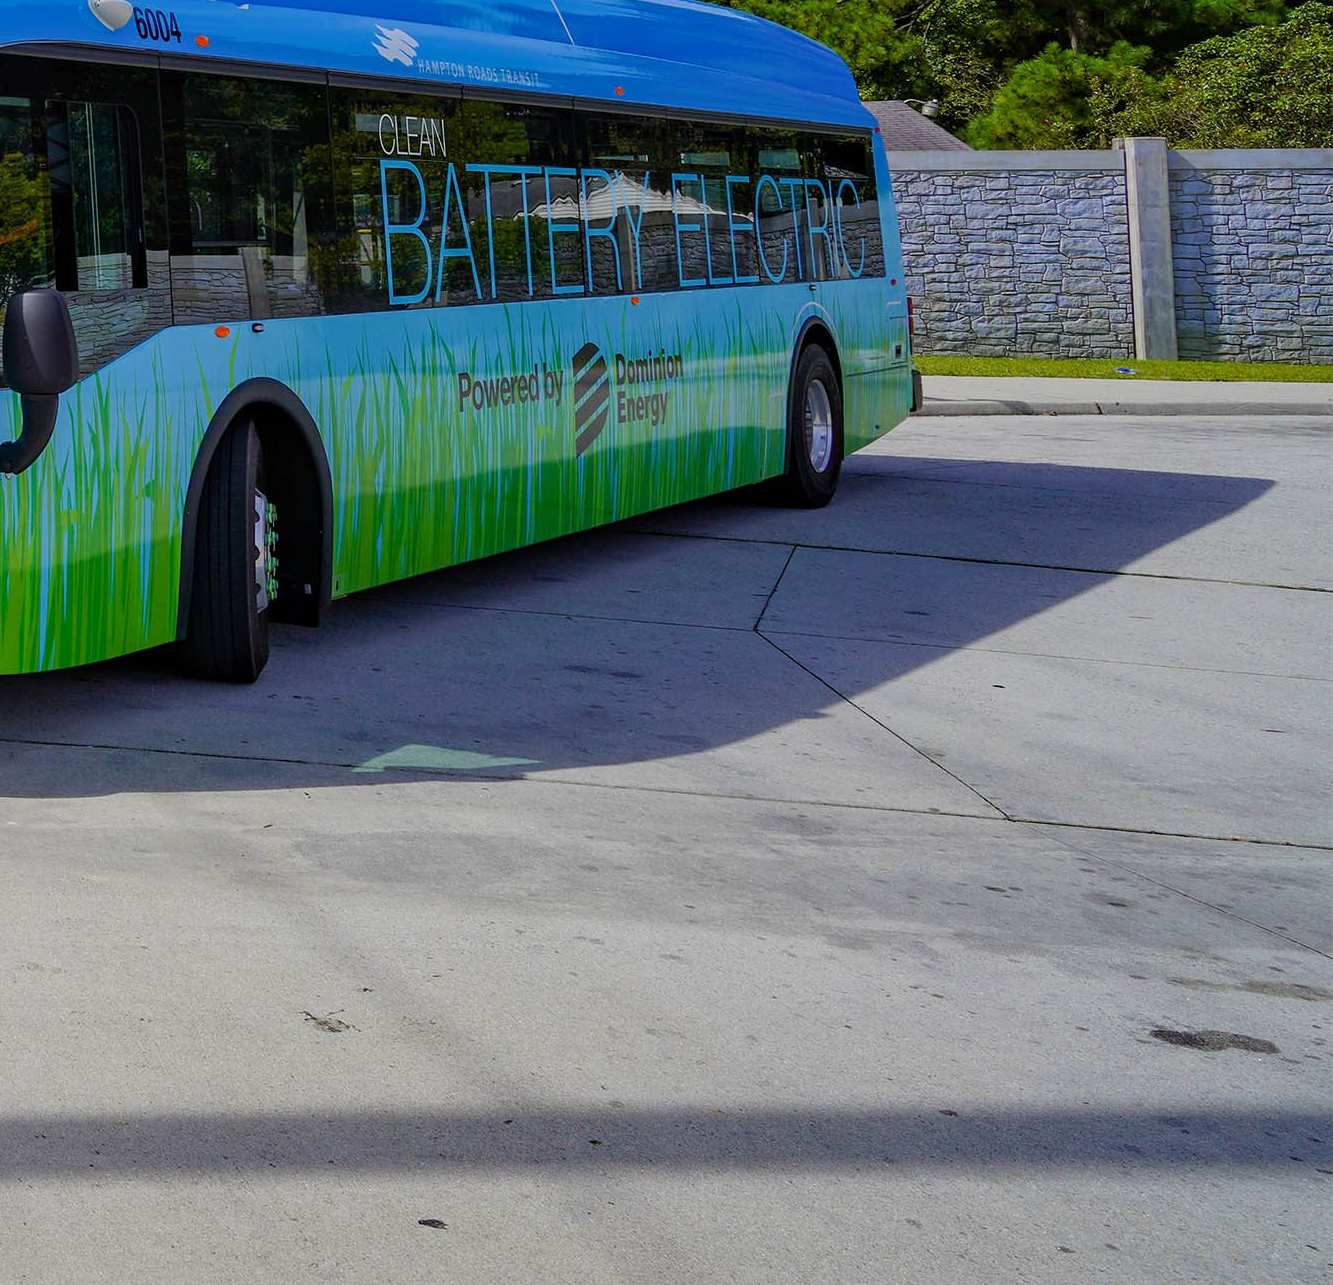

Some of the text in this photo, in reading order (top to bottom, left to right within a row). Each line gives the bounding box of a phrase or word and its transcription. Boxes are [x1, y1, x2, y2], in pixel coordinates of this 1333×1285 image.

[133, 7, 182, 44] 6004
[418, 58, 541, 87] HAMPTON ROADS TRANSIT
[379, 113, 447, 158] CLEAN
[380, 158, 866, 306] BATTERY ELECTRIC
[615, 349, 684, 386] Dominion
[458, 362, 564, 412] Powered by
[617, 391, 669, 426] Energy
